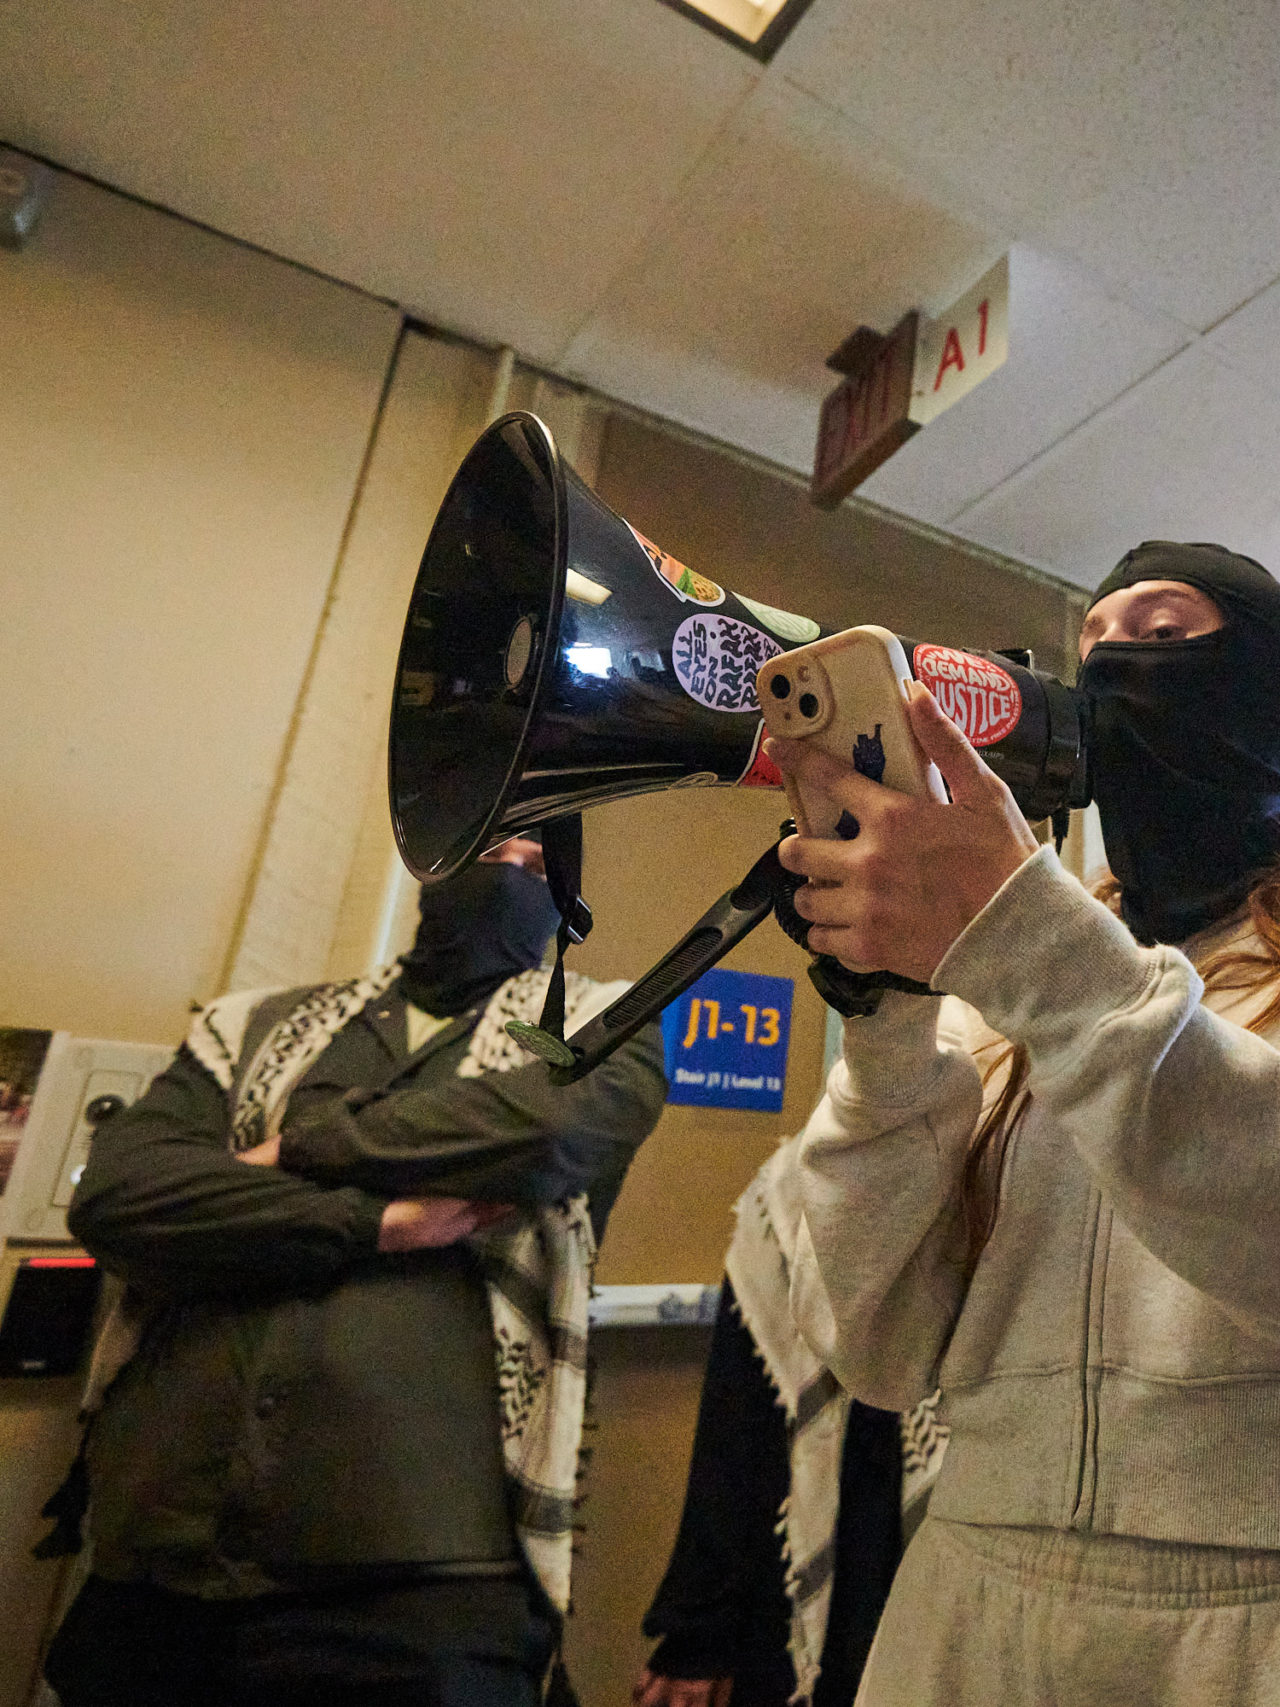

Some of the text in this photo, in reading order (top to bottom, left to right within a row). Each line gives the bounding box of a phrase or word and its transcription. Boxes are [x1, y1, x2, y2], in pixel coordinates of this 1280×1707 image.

[676, 630, 693, 680] ALL
[690, 620, 707, 696] EYES
[705, 656, 718, 704] ON
[716, 618, 743, 709] RAFAH
[922, 658, 1011, 691] DEMAND
[935, 680, 1011, 737] JUSTICE
[682, 998, 780, 1048] J1-13
